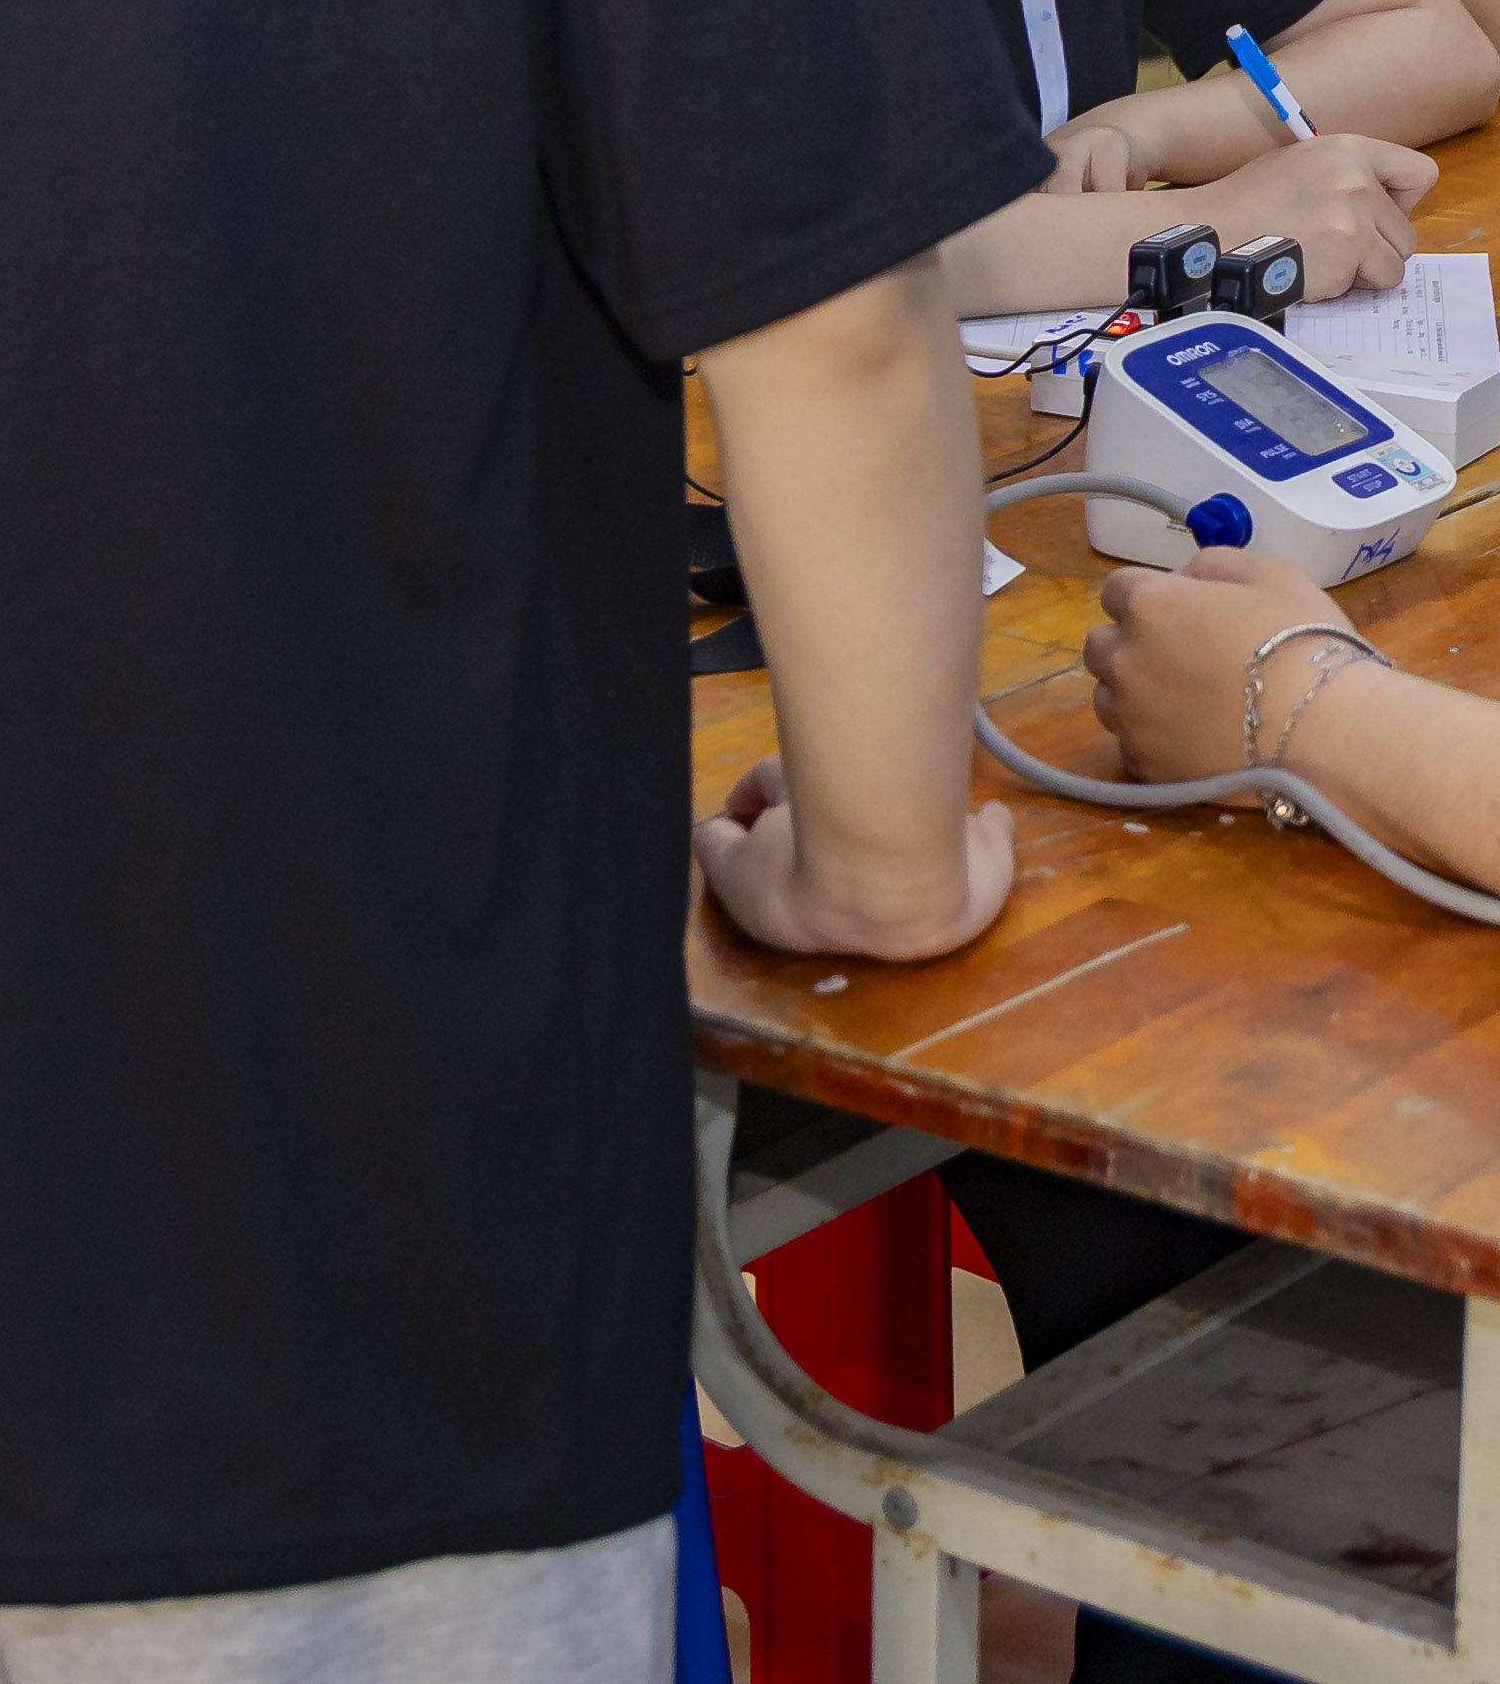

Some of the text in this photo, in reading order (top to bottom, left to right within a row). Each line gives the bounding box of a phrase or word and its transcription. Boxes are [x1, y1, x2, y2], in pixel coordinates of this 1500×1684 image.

[1166, 341, 1221, 366] OMRON
[1259, 443, 1291, 459] PULSE
[1347, 468, 1373, 483] START
[1362, 479, 1383, 493] STOP
